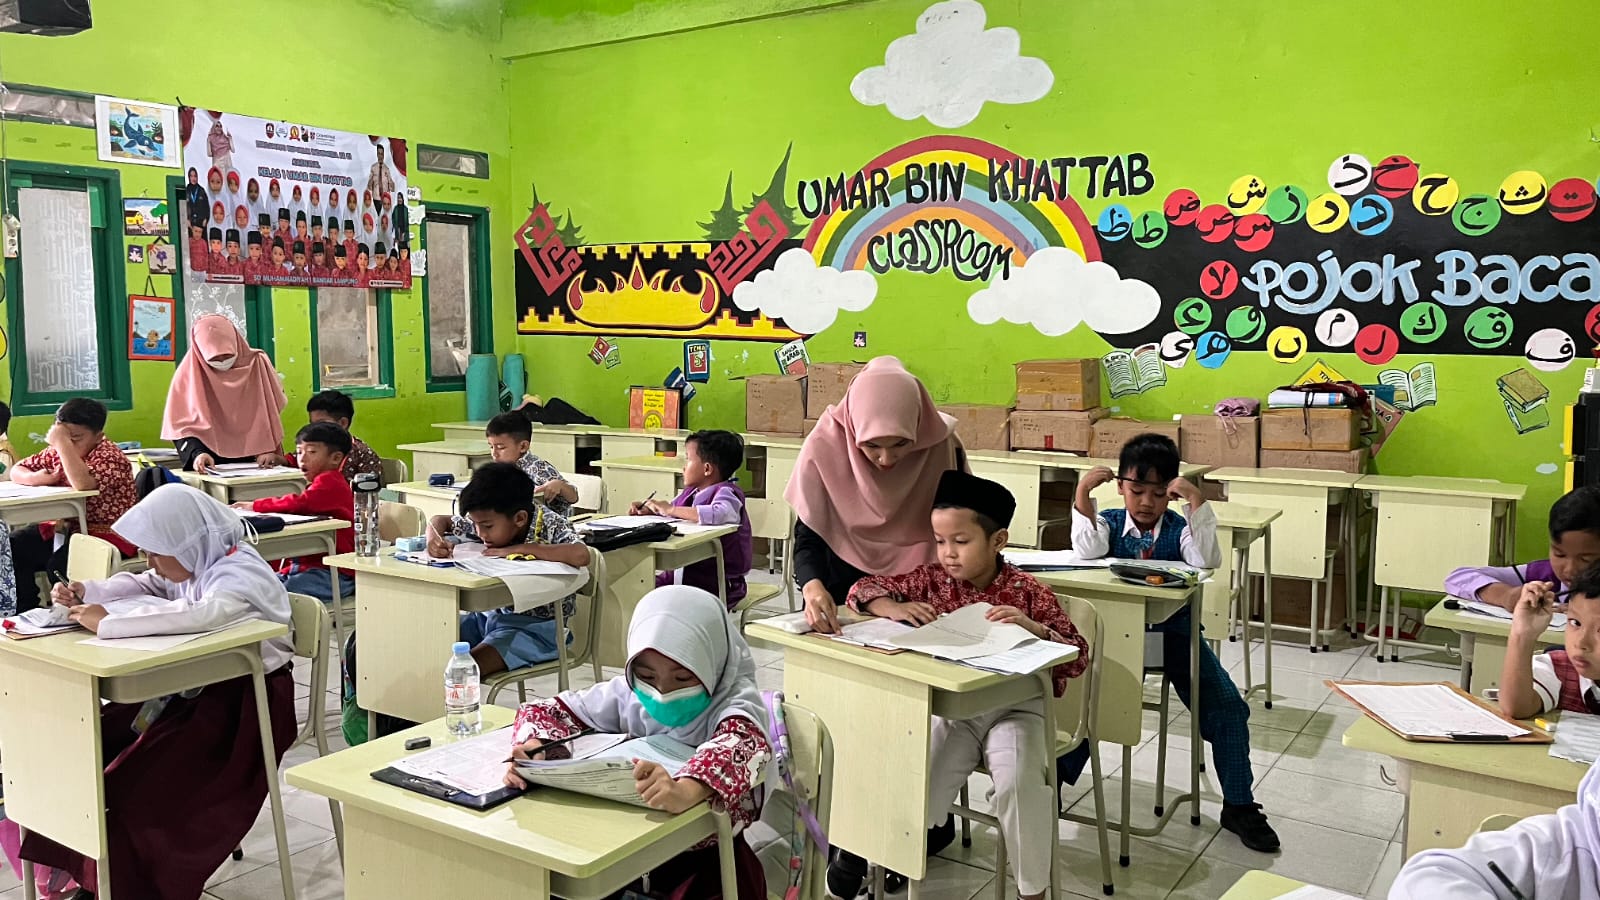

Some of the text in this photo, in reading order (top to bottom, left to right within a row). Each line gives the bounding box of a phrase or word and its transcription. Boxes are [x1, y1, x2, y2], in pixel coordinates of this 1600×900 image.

[258, 167, 281, 179] KELAS
[798, 152, 1155, 219] UMAR BIN KHATTAB
[1373, 157, 1412, 192] خ
[1228, 178, 1267, 208] ش
[1135, 214, 1164, 243] ط
[1460, 198, 1489, 229] ج
[1431, 249, 1600, 306] Baca
[1467, 311, 1507, 343] ق
[1526, 337, 1574, 363] ف
